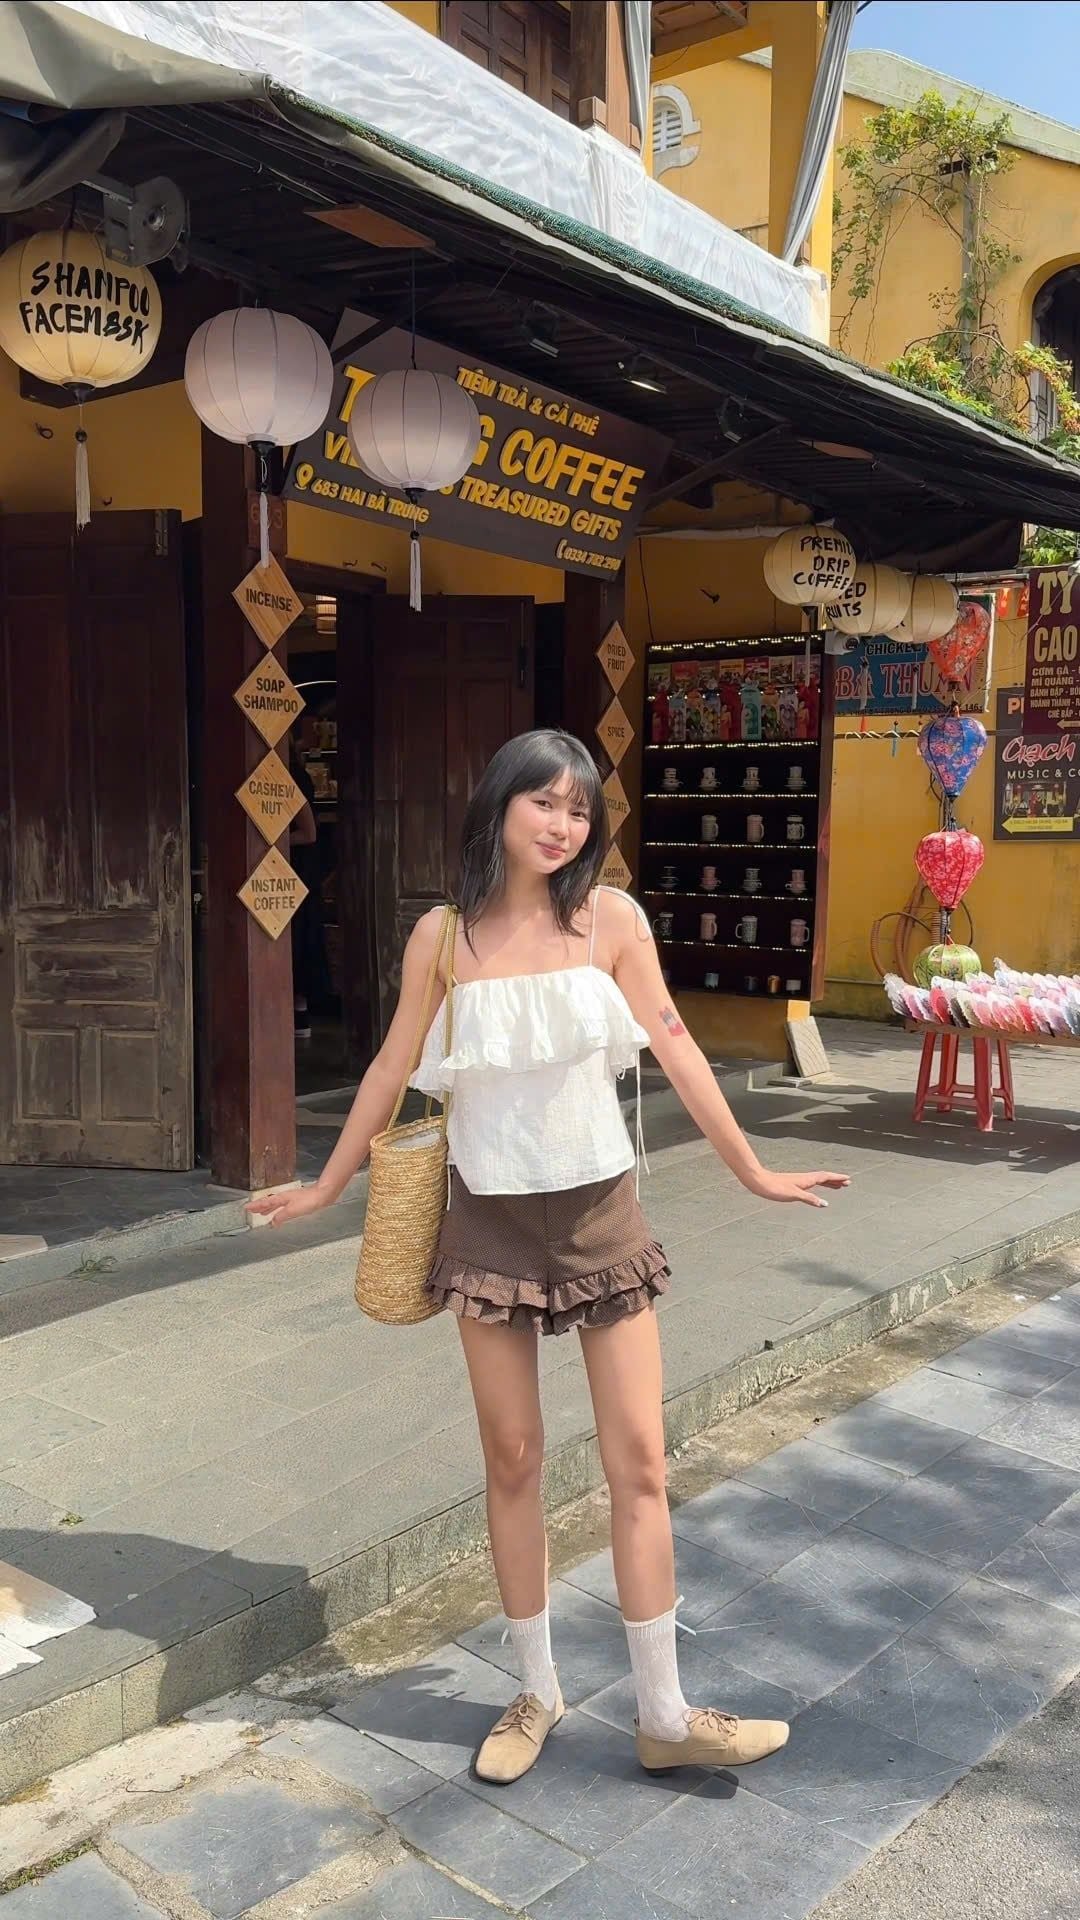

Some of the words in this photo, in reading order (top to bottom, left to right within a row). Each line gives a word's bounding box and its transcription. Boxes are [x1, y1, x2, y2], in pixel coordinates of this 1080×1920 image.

[497, 383, 529, 410] TRÀ
[528, 395, 544, 415] &
[544, 401, 570, 426] CÀ
[568, 411, 600, 436] PHÊ
[499, 428, 646, 511] COFFEE
[311, 478, 339, 498] 683
[339, 485, 366, 507] HAI
[366, 489, 388, 512] BÀ
[458, 475, 571, 528] TREASURED
[570, 509, 623, 541] GIFTS
[813, 555, 850, 575] DRIP
[245, 588, 293, 612] INCENSE
[607, 643, 626, 657] DRIED
[866, 641, 922, 656] CHICKE
[1034, 624, 1078, 663] CAO
[607, 658, 625, 671] FRUIT
[256, 677, 285, 694] SOAP
[243, 694, 299, 714] SHAMPOO
[607, 726, 625, 738] SPICE
[1007, 769, 1050, 780] MUSIC
[1054, 768, 1062, 778] &
[249, 780, 296, 799] CASHEW
[261, 800, 283, 815] NUT
[603, 867, 625, 879] AROMA
[251, 878, 298, 893] INSTANT
[253, 896, 296, 911] COFFEE
